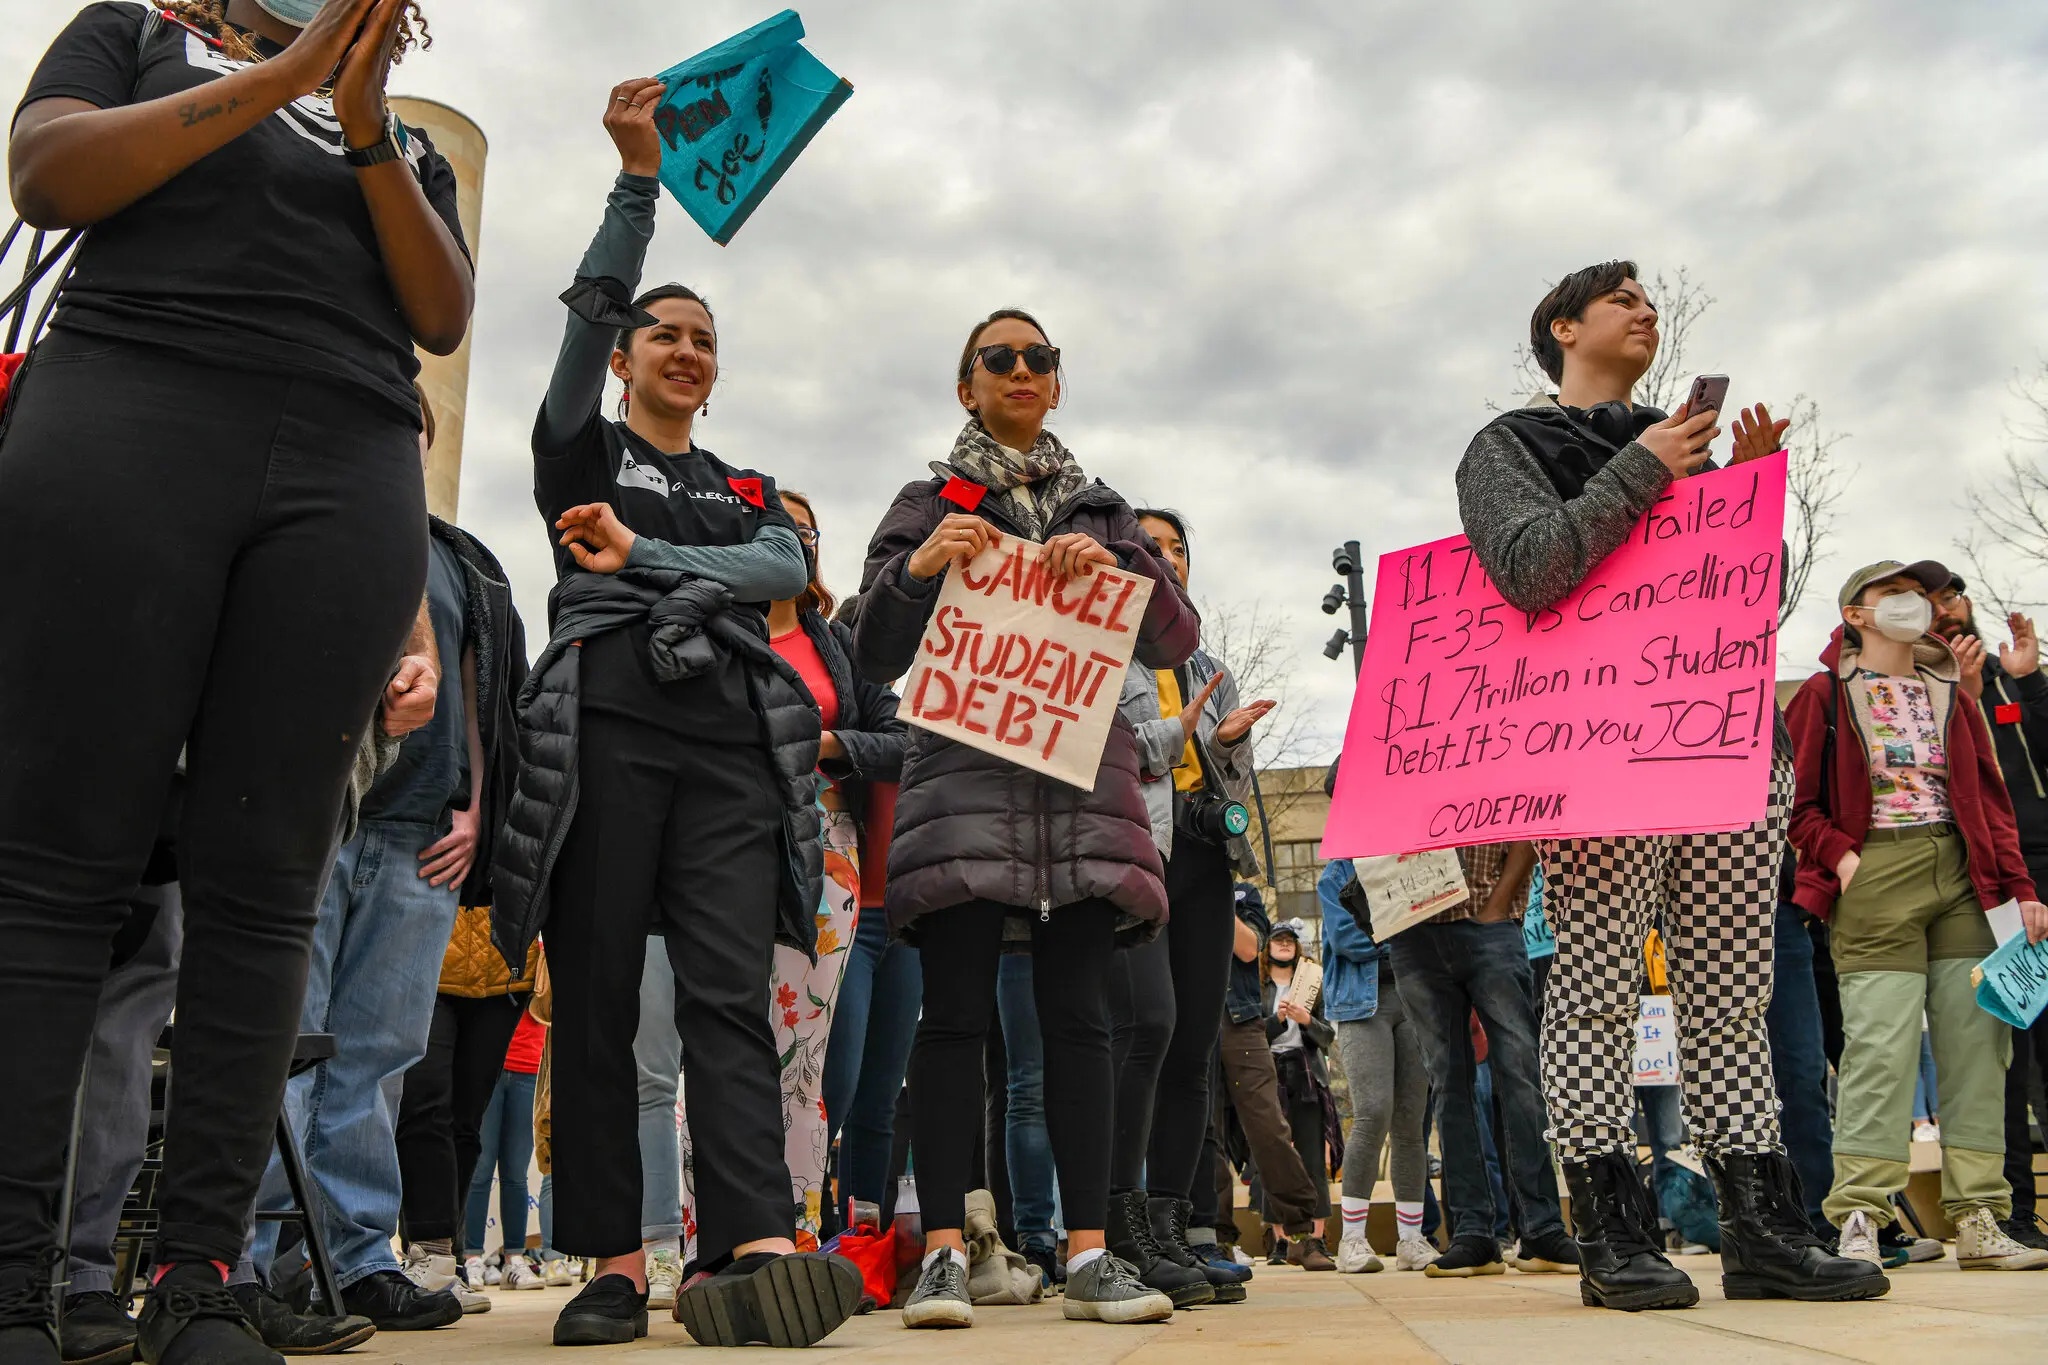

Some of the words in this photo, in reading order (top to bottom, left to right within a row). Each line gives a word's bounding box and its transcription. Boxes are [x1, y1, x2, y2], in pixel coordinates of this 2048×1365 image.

[961, 537, 1137, 633] CANCEL
[1405, 602, 1506, 664] F-35
[1577, 552, 1775, 622] Cancelling
[925, 605, 1123, 708] STUDENT
[1584, 656, 1618, 687] in
[1633, 619, 1777, 686] Student
[911, 667, 1080, 761] DEBT
[1578, 718, 1644, 751] you
[1631, 678, 1766, 756] JOE!
[1428, 793, 1568, 838] CODEPINK
